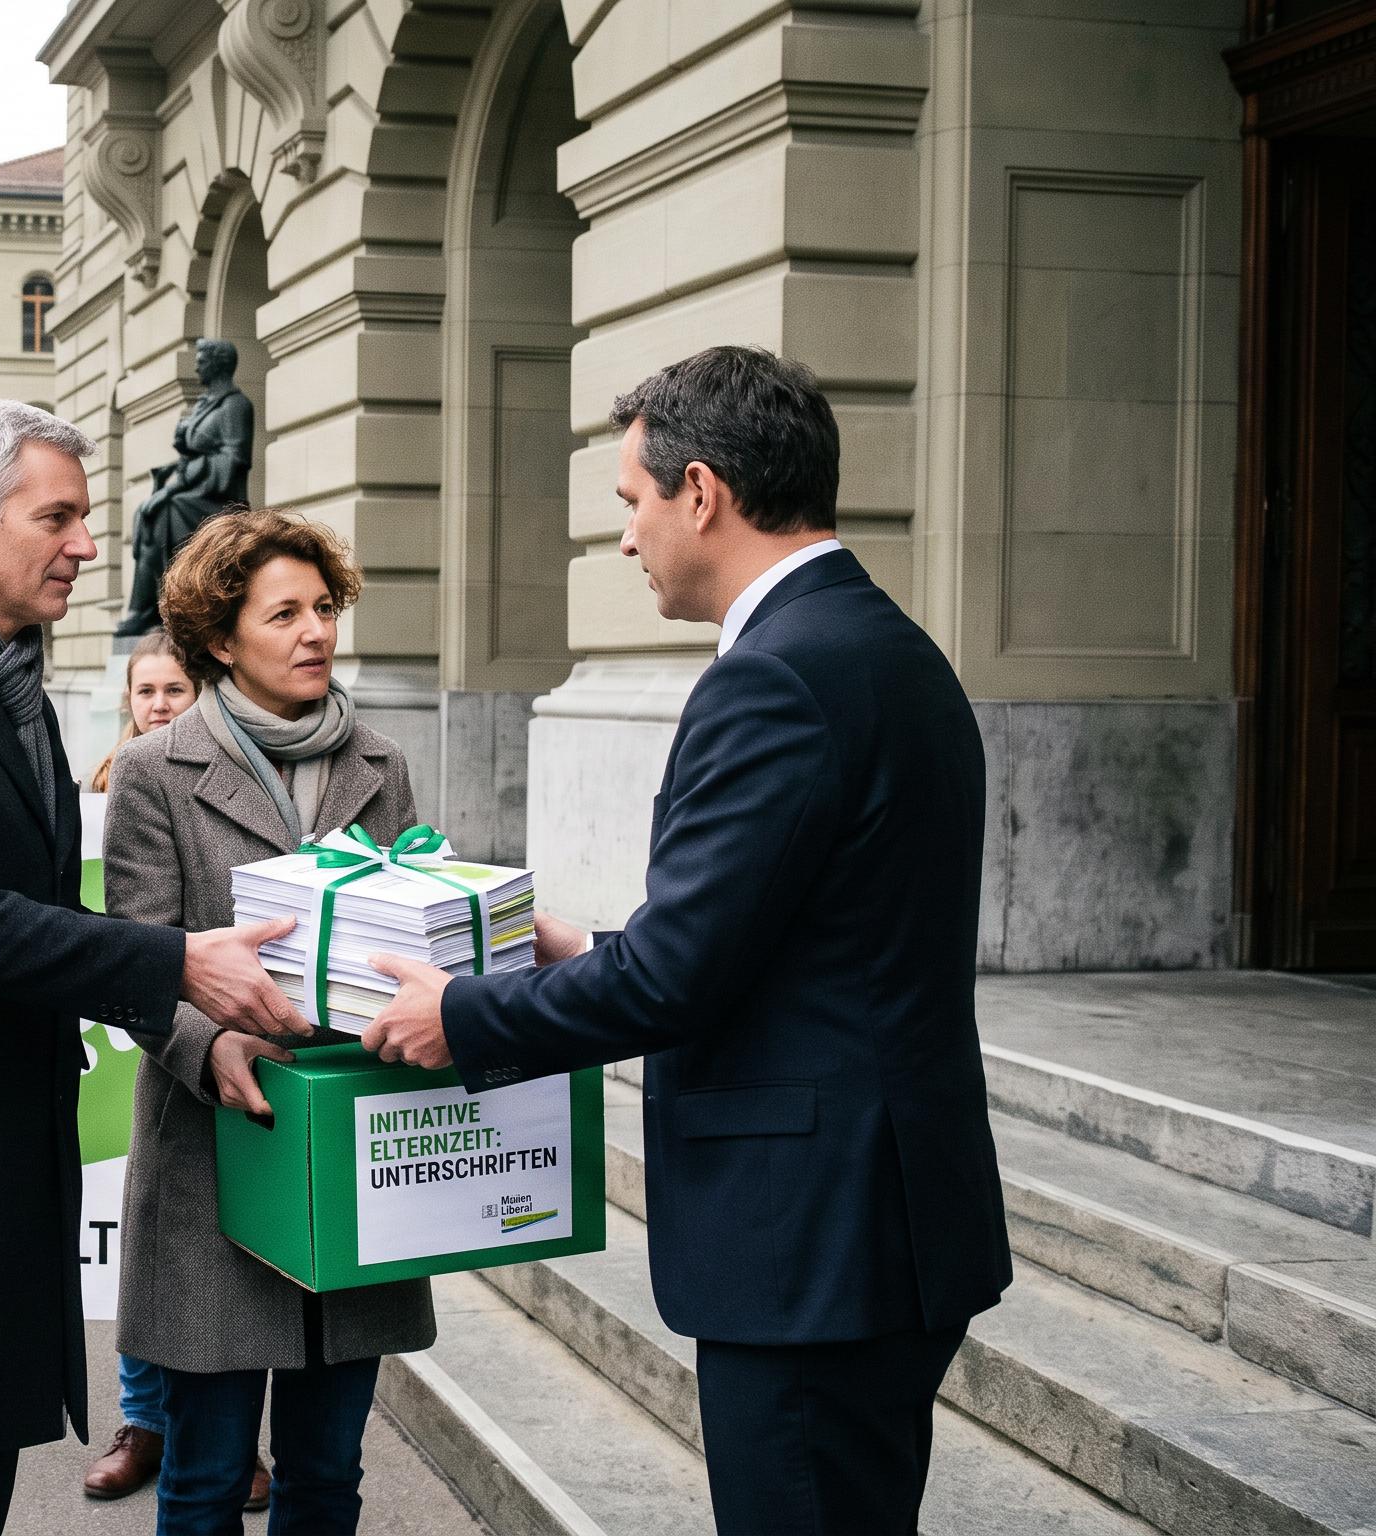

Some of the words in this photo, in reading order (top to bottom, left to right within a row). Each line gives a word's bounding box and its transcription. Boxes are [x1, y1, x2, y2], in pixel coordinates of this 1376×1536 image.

[370, 1101, 481, 1134] INITIATIVE
[371, 1127, 501, 1162] ELTERNZEIT:
[371, 1146, 557, 1189] UNTERSCHRIFTEN
[501, 1202, 533, 1216] Liberal
